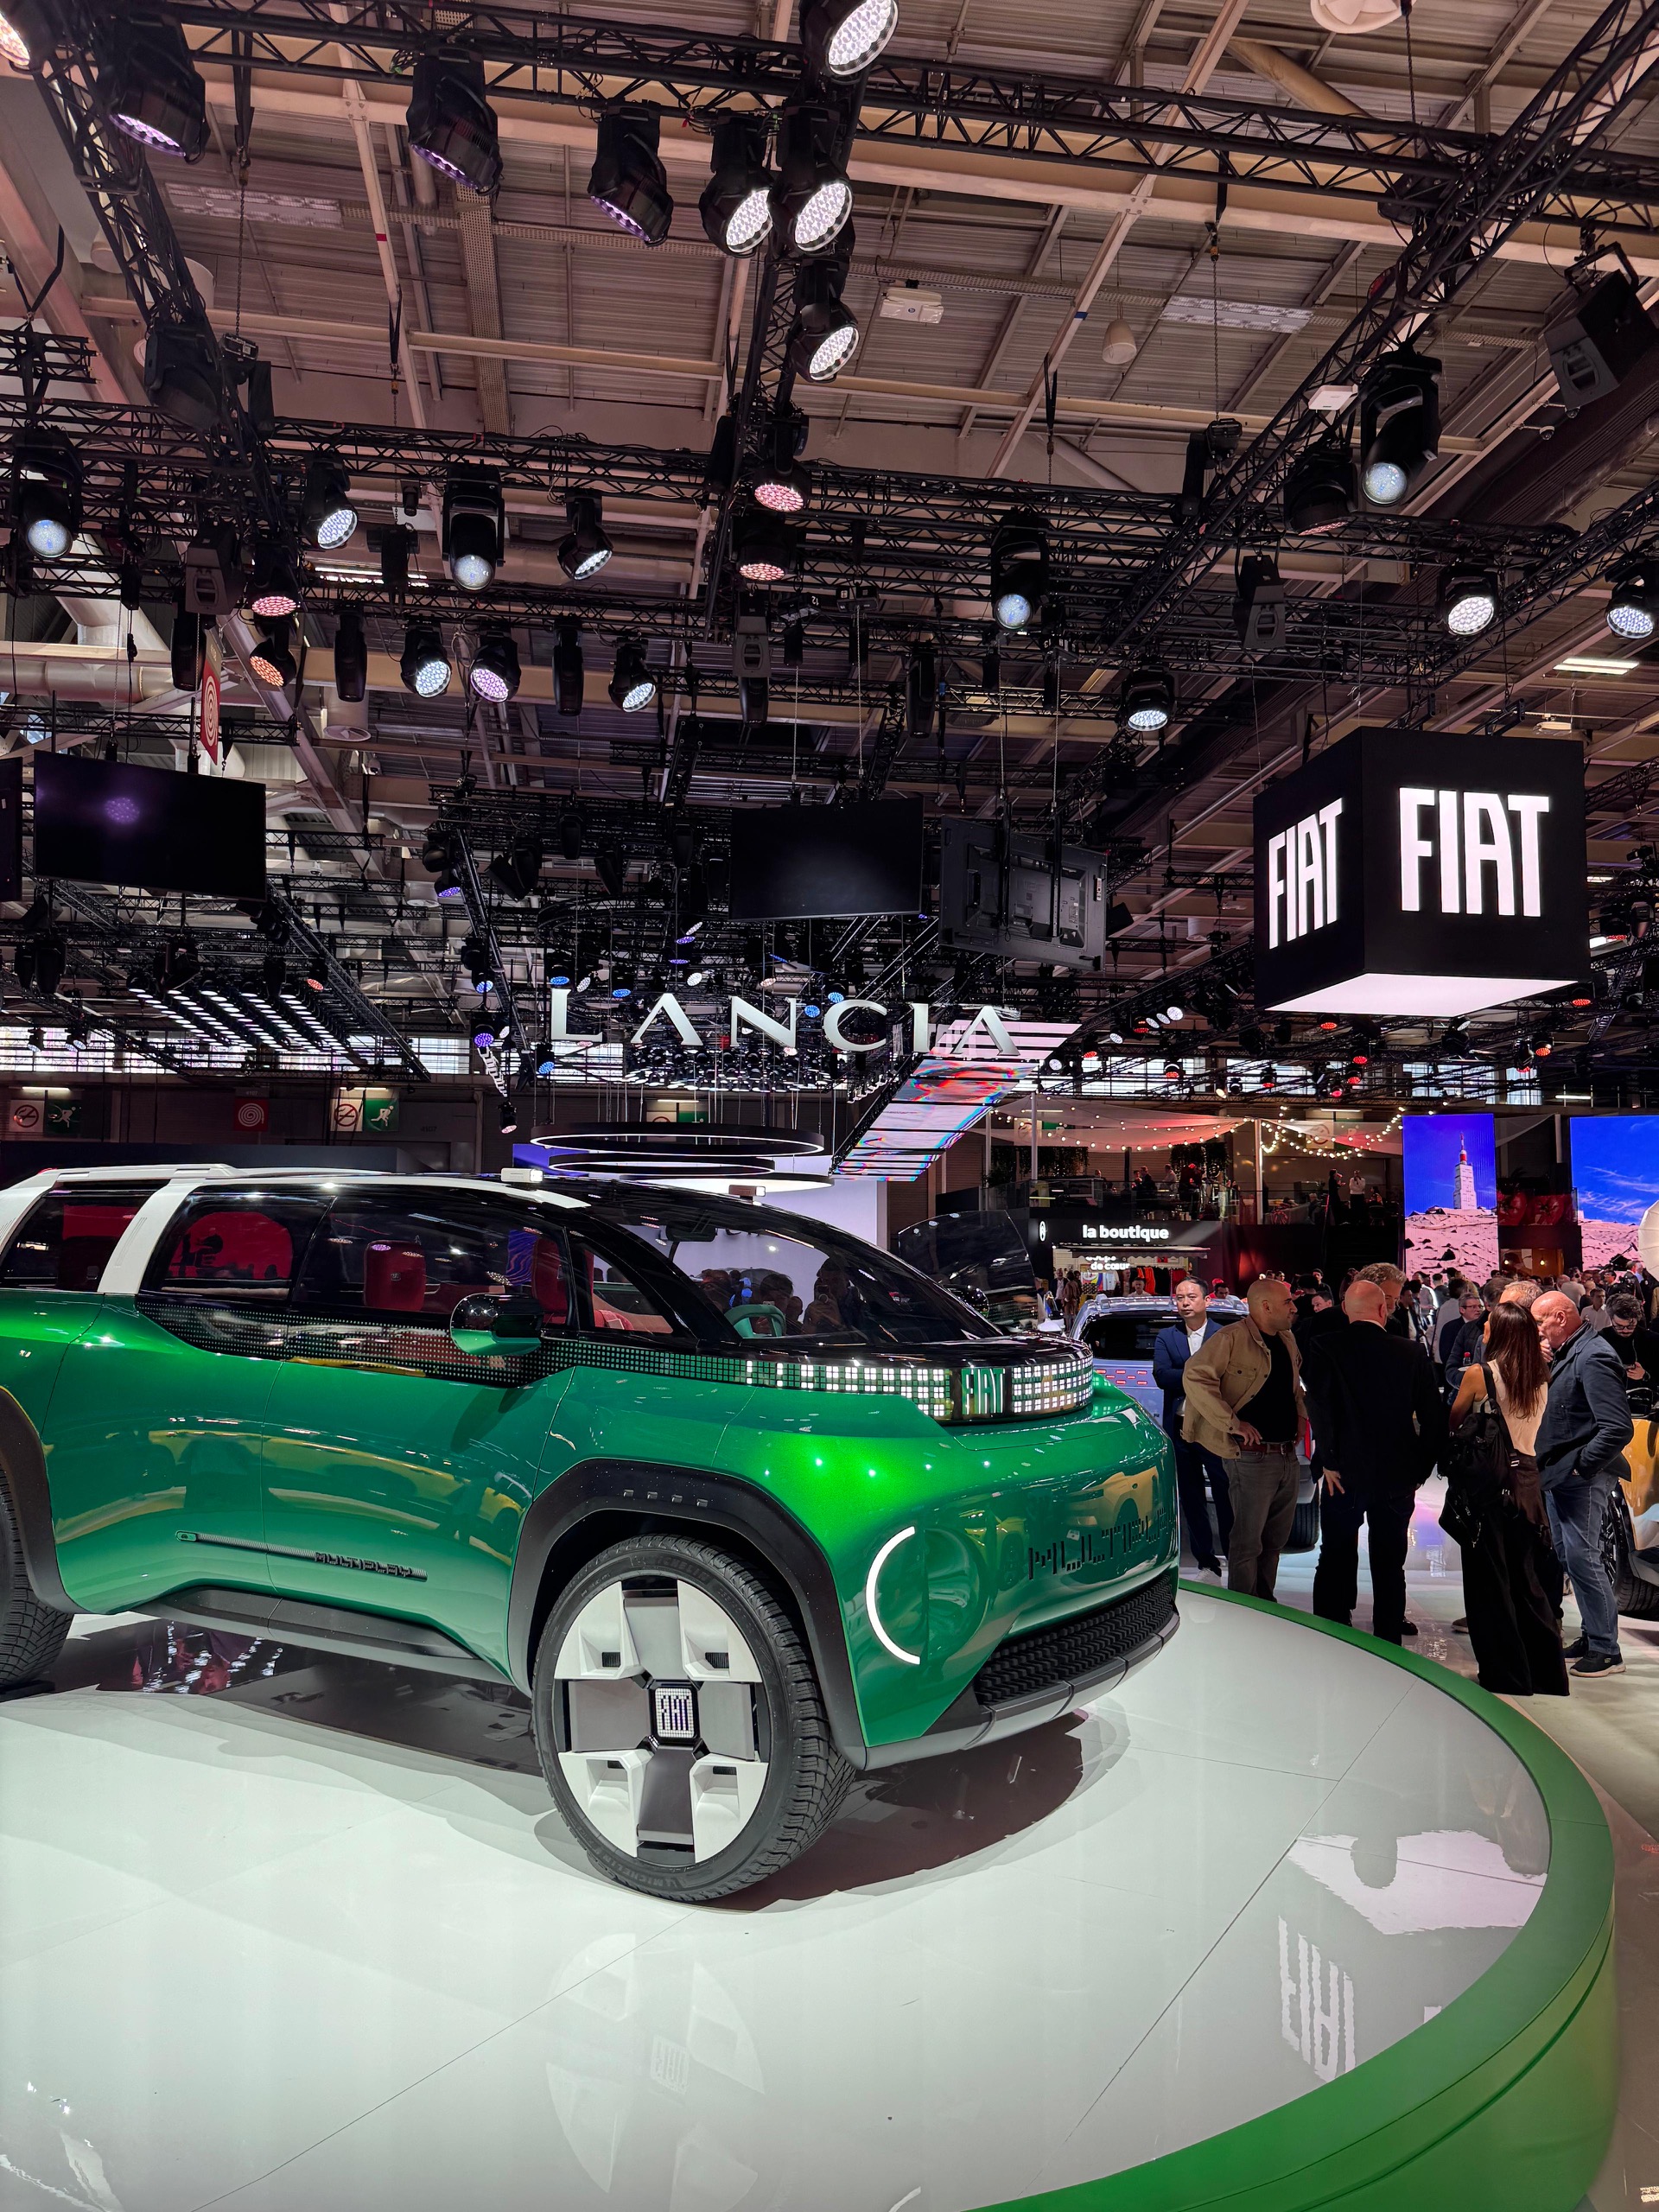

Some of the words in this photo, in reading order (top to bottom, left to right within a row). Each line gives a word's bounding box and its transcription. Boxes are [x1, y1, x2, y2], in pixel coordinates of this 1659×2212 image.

[1268, 798, 1343, 949] FIAT
[1399, 787, 1549, 917] FIAT
[550, 988, 1020, 1056] LANCIA
[1083, 1224, 1096, 1238] la
[1099, 1224, 1169, 1242] boutique
[1090, 1262, 1103, 1270] de
[962, 1368, 1005, 1414] FIAT
[661, 1695, 690, 1732] FIAT
